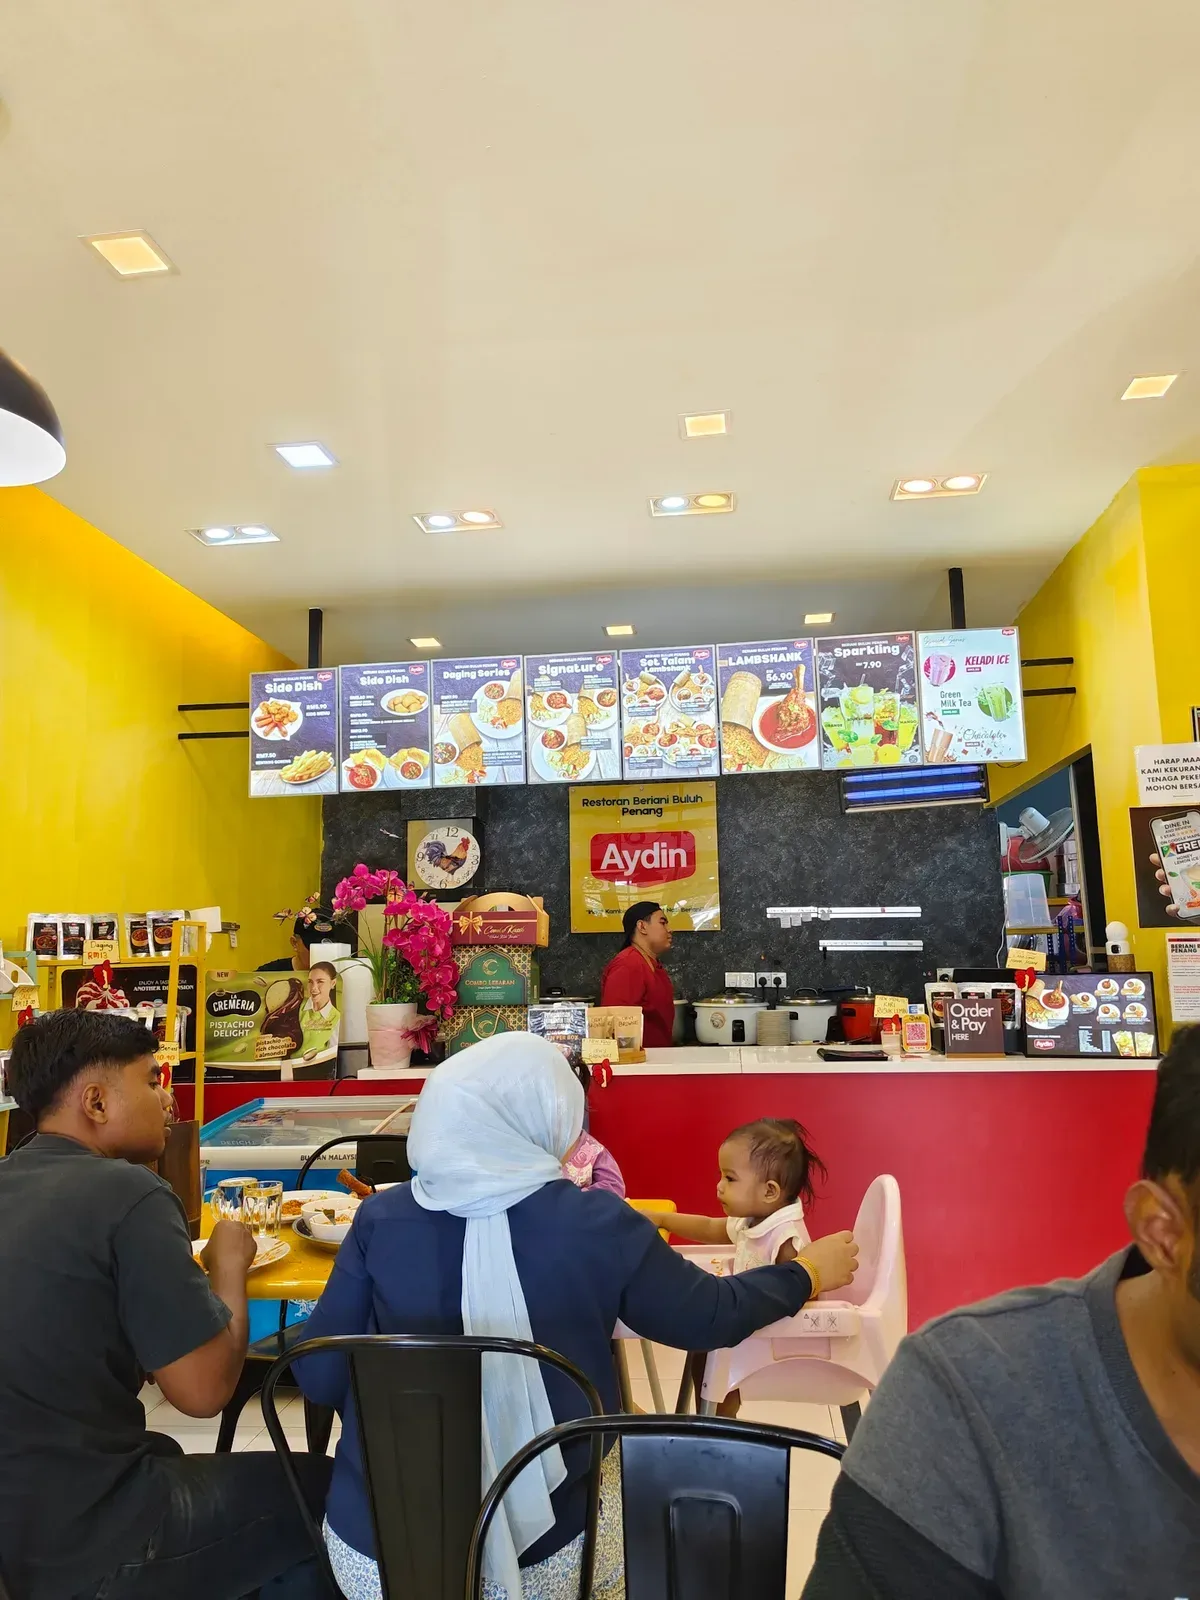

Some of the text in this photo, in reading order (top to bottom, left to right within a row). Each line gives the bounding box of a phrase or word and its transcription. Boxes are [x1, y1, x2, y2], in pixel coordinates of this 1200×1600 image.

[834, 645, 900, 658] Sparkling
[640, 656, 695, 667] Set Talam
[728, 652, 802, 666] LAMBSHANK
[863, 660, 882, 669] 7.90
[965, 655, 1010, 666] KELADI ICE
[443, 668, 511, 680] Daging Series
[538, 663, 604, 677] Signature
[644, 665, 691, 673] Lambshank
[360, 674, 409, 686] Side Dish
[766, 672, 793, 682] 56.90
[265, 681, 322, 694] Side Dish
[940, 690, 961, 699] Green
[941, 699, 972, 708] Milk Tea
[582, 794, 703, 807] Restoran Beriani Buluh
[621, 807, 663, 817] Penang
[1164, 821, 1181, 830] DINE
[445, 826, 459, 838] 12
[416, 851, 425, 862] 9
[471, 855, 479, 865] 3
[600, 842, 687, 876] Aydin
[440, 878, 447, 889] 6
[90, 941, 113, 951] Daging
[212, 998, 255, 1013] CREMERIA
[950, 1002, 994, 1017] Order
[209, 1020, 255, 1029] PISTACHIO
[951, 1017, 986, 1034] & Pay
[213, 1029, 250, 1037] DELIGHT
[951, 1033, 970, 1041] HERE
[256, 1039, 281, 1047] pistachio
[268, 1042, 296, 1050] chocolate
[259, 1049, 286, 1058] almonds!
